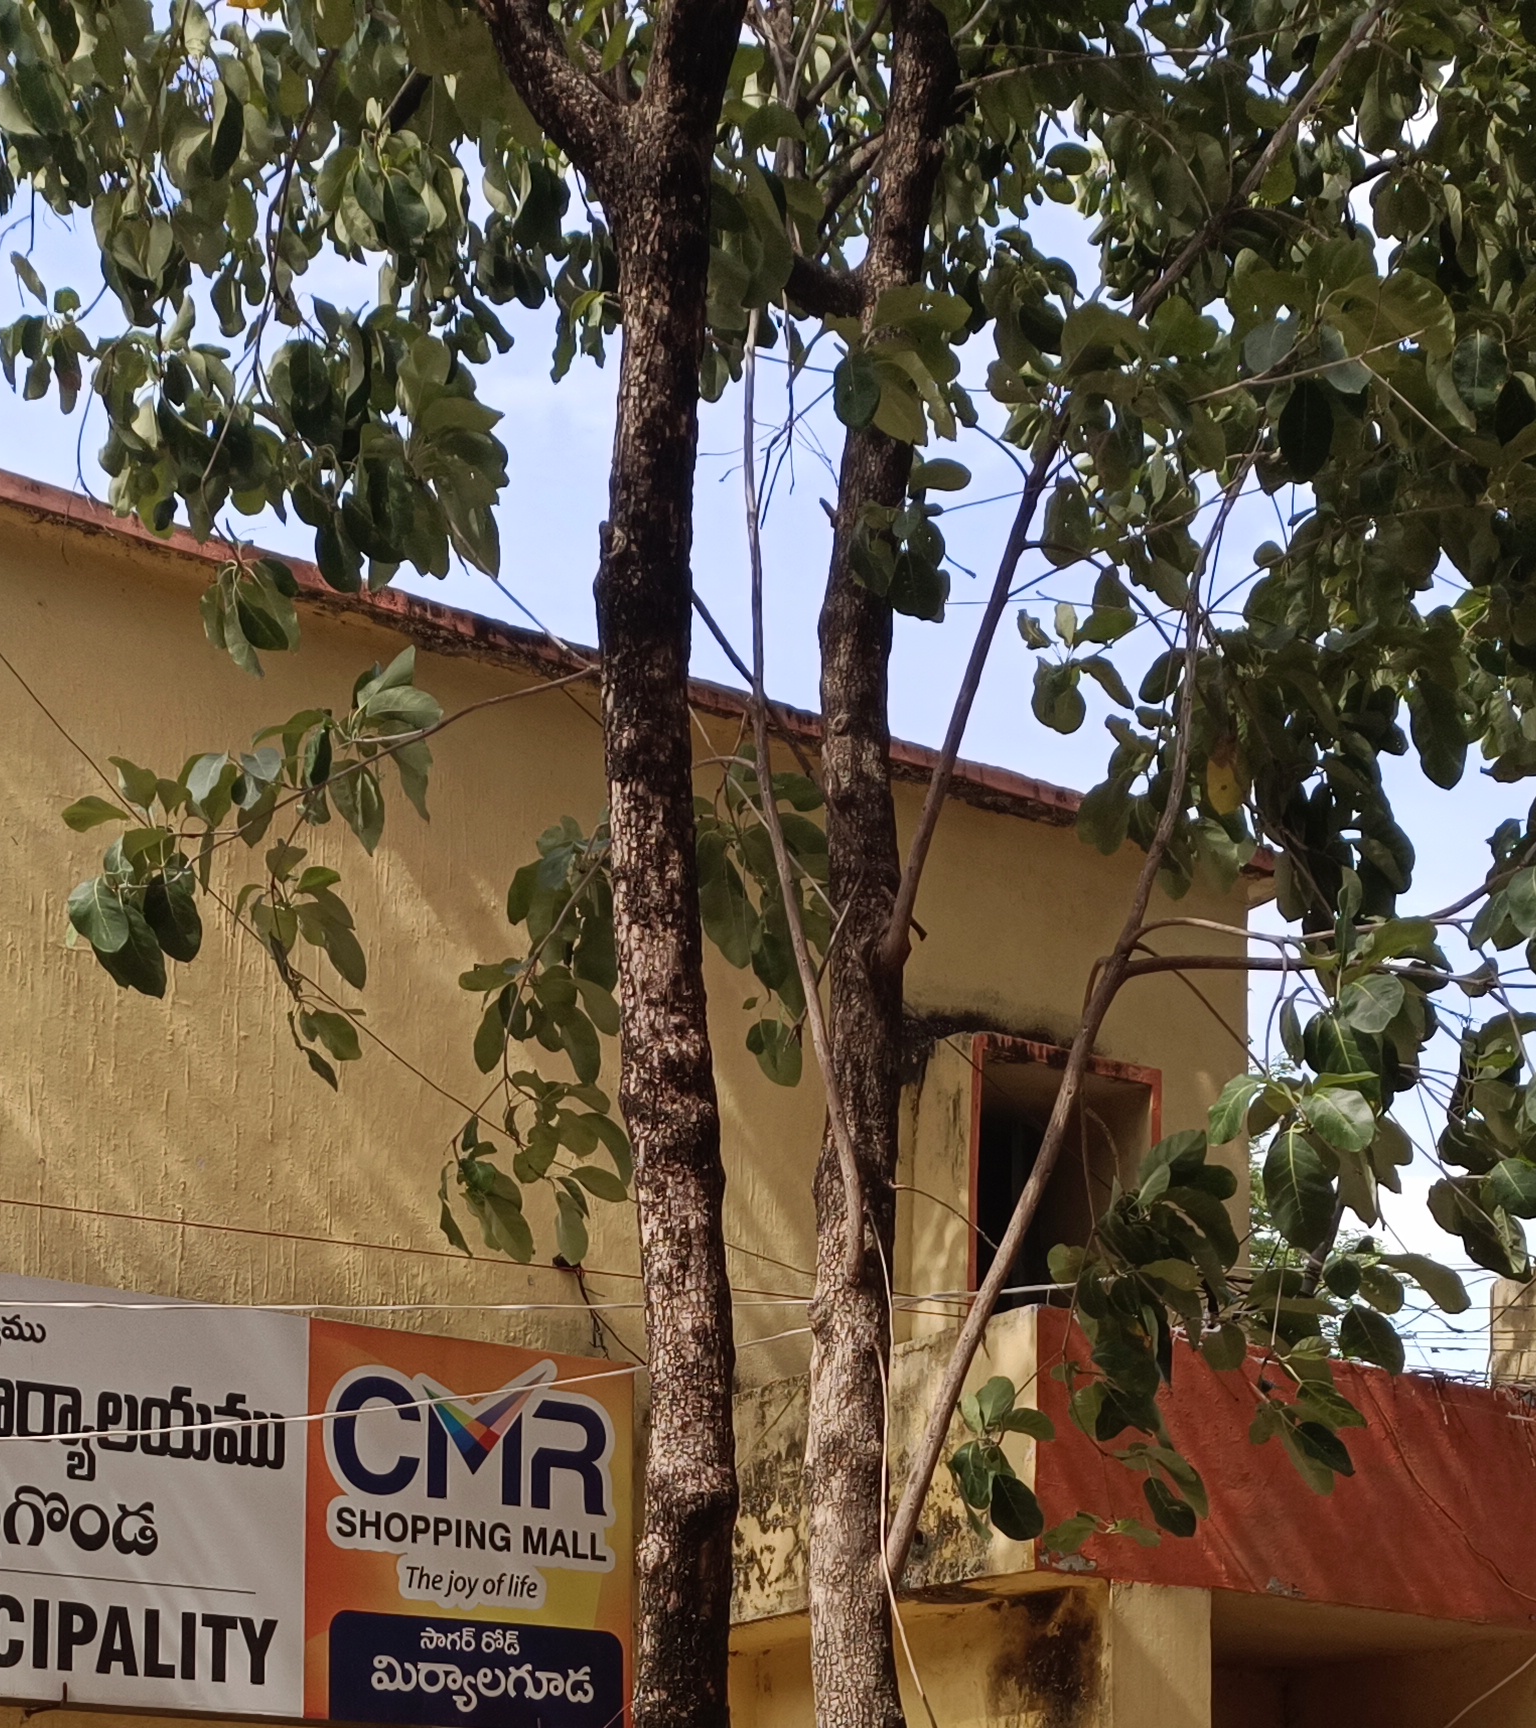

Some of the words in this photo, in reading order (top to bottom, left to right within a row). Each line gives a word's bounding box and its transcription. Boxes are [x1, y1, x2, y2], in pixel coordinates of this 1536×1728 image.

[332, 1370, 608, 1517] CMR
[335, 1505, 512, 1553] SHOPPING
[522, 1525, 608, 1563] MALL
[405, 1565, 443, 1592] The
[443, 1571, 480, 1600] joy
[482, 1571, 506, 1597] of
[506, 1573, 539, 1599] life
[419, 1626, 476, 1654] సాగర్
[480, 1629, 521, 1656] రోడ్
[369, 1654, 596, 1713] మిర్యాలగూడ
